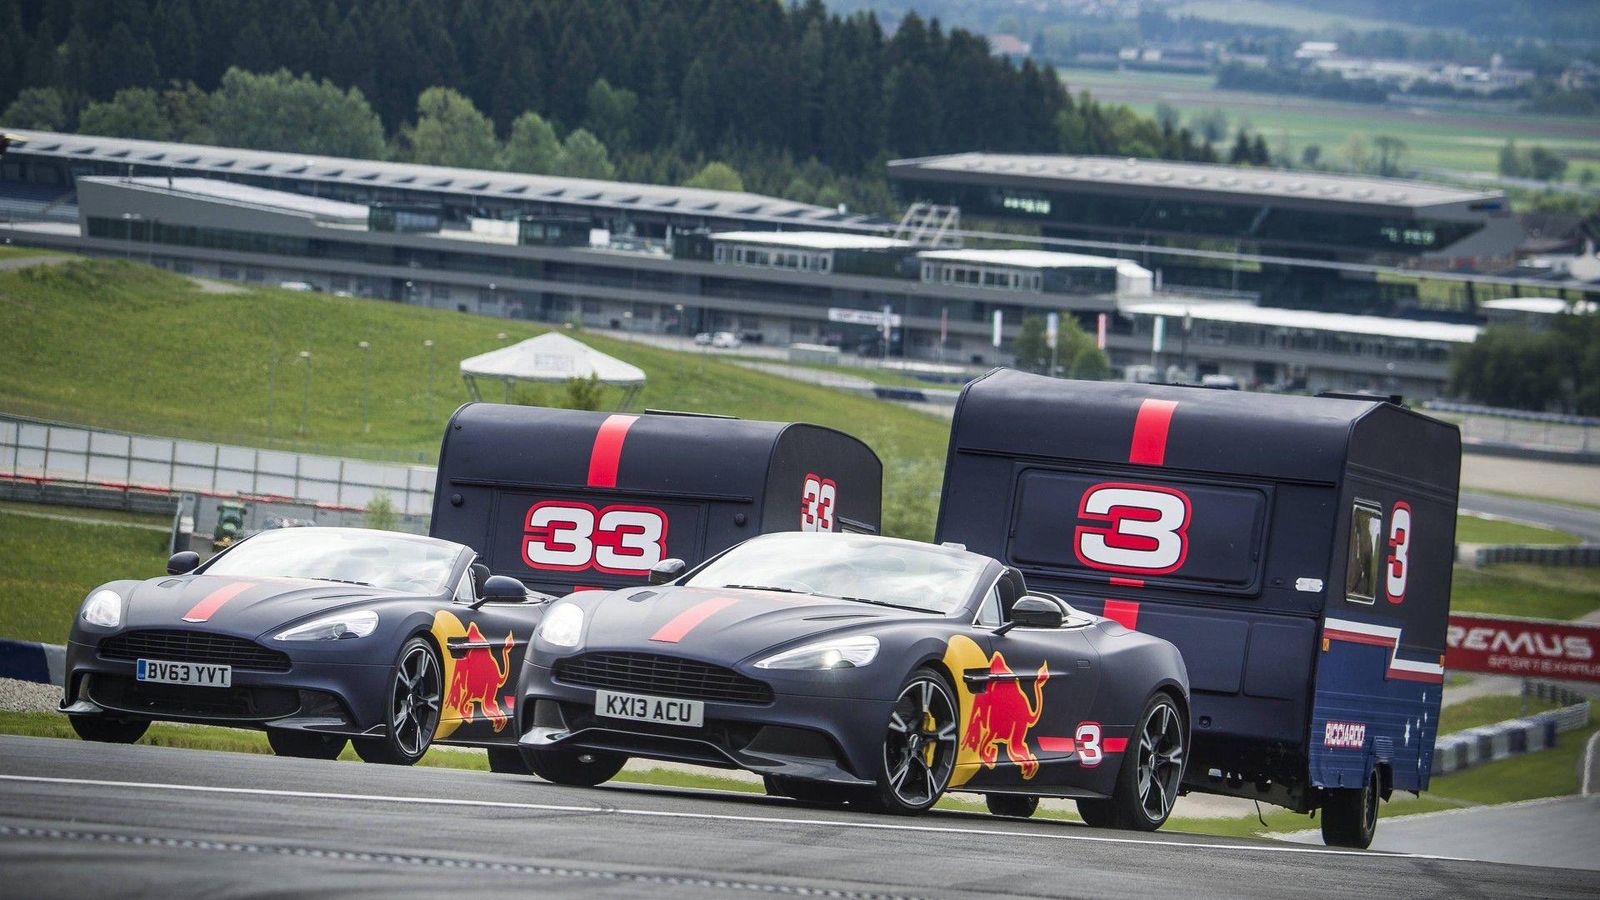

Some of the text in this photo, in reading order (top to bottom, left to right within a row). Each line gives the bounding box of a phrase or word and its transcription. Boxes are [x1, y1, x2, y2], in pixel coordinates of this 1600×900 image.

[802, 473, 836, 532] 33
[1075, 483, 1191, 574] 3
[522, 501, 668, 575] 33
[1384, 501, 1411, 604] 3
[1446, 624, 1593, 659] REMUS
[147, 662, 228, 684] BV63 YVT
[606, 695, 692, 722] KX13 ACU
[1074, 721, 1103, 768] 3
